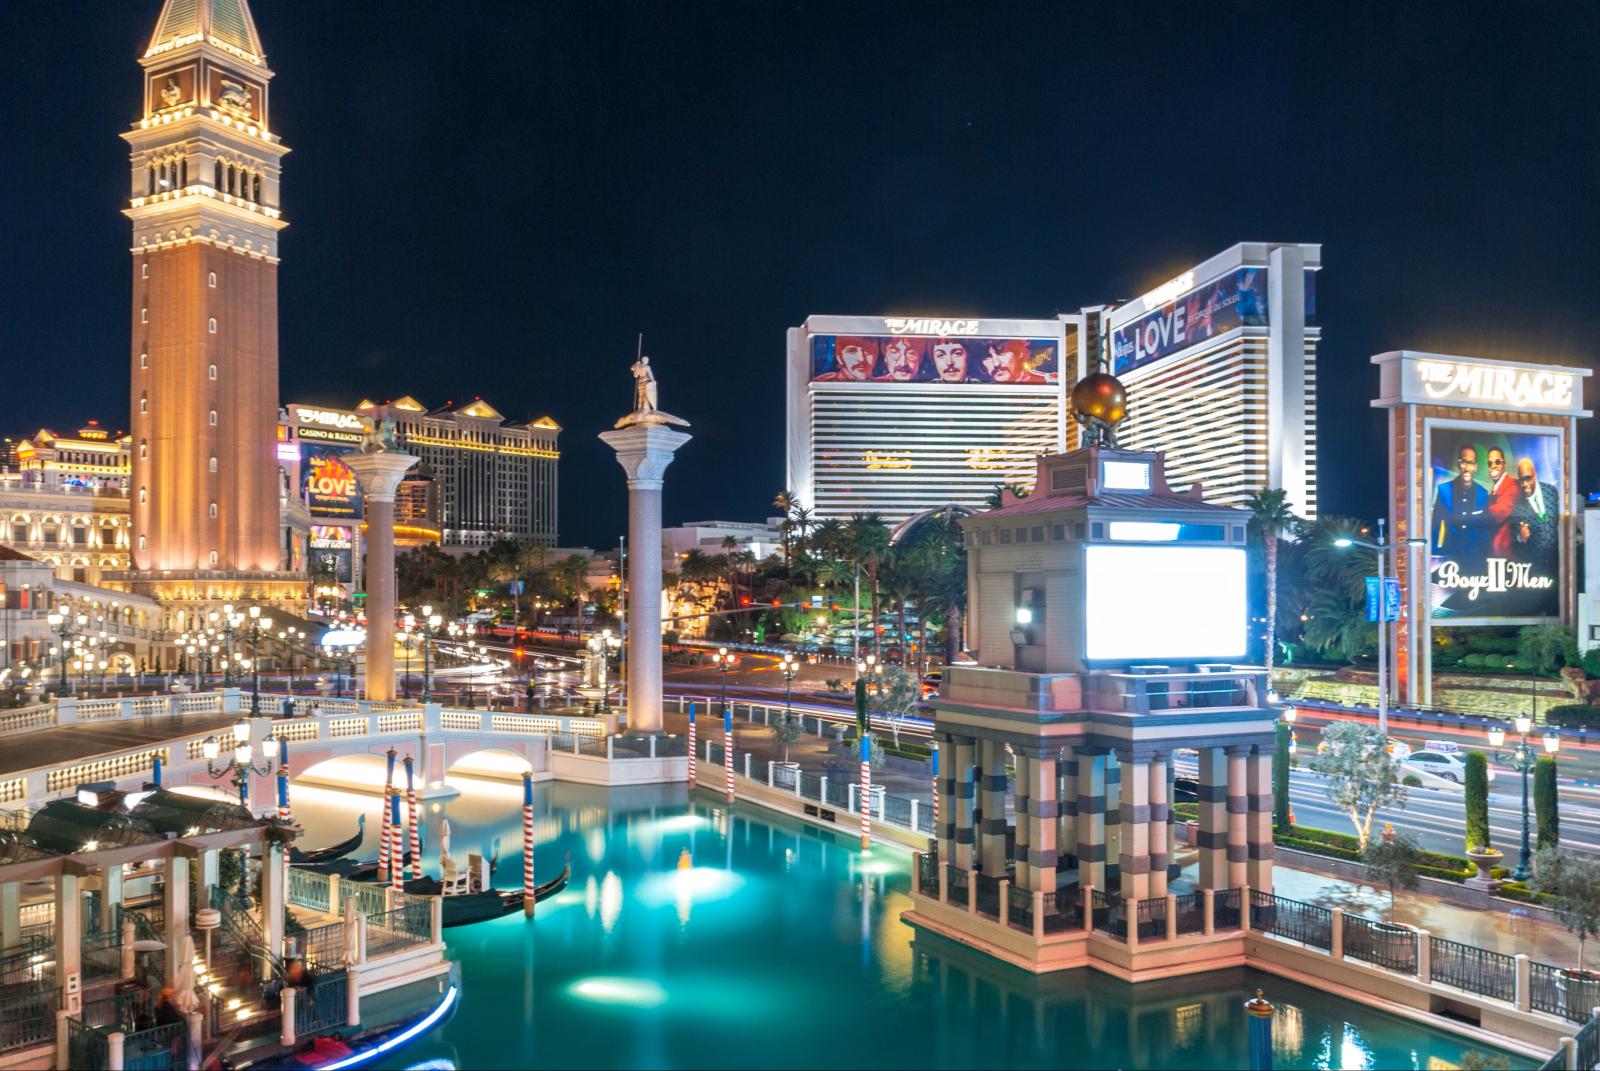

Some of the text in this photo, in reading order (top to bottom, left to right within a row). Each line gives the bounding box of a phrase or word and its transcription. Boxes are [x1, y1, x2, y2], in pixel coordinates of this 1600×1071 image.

[884, 318, 979, 336] THE MIRAGE
[1135, 306, 1186, 360] LOVE
[1416, 360, 1574, 408] THE MIRAGE
[299, 428, 327, 439] CASINO
[334, 432, 362, 442] RESORT
[308, 476, 356, 496] LOVE
[1438, 557, 1553, 601] Boyz II Men
